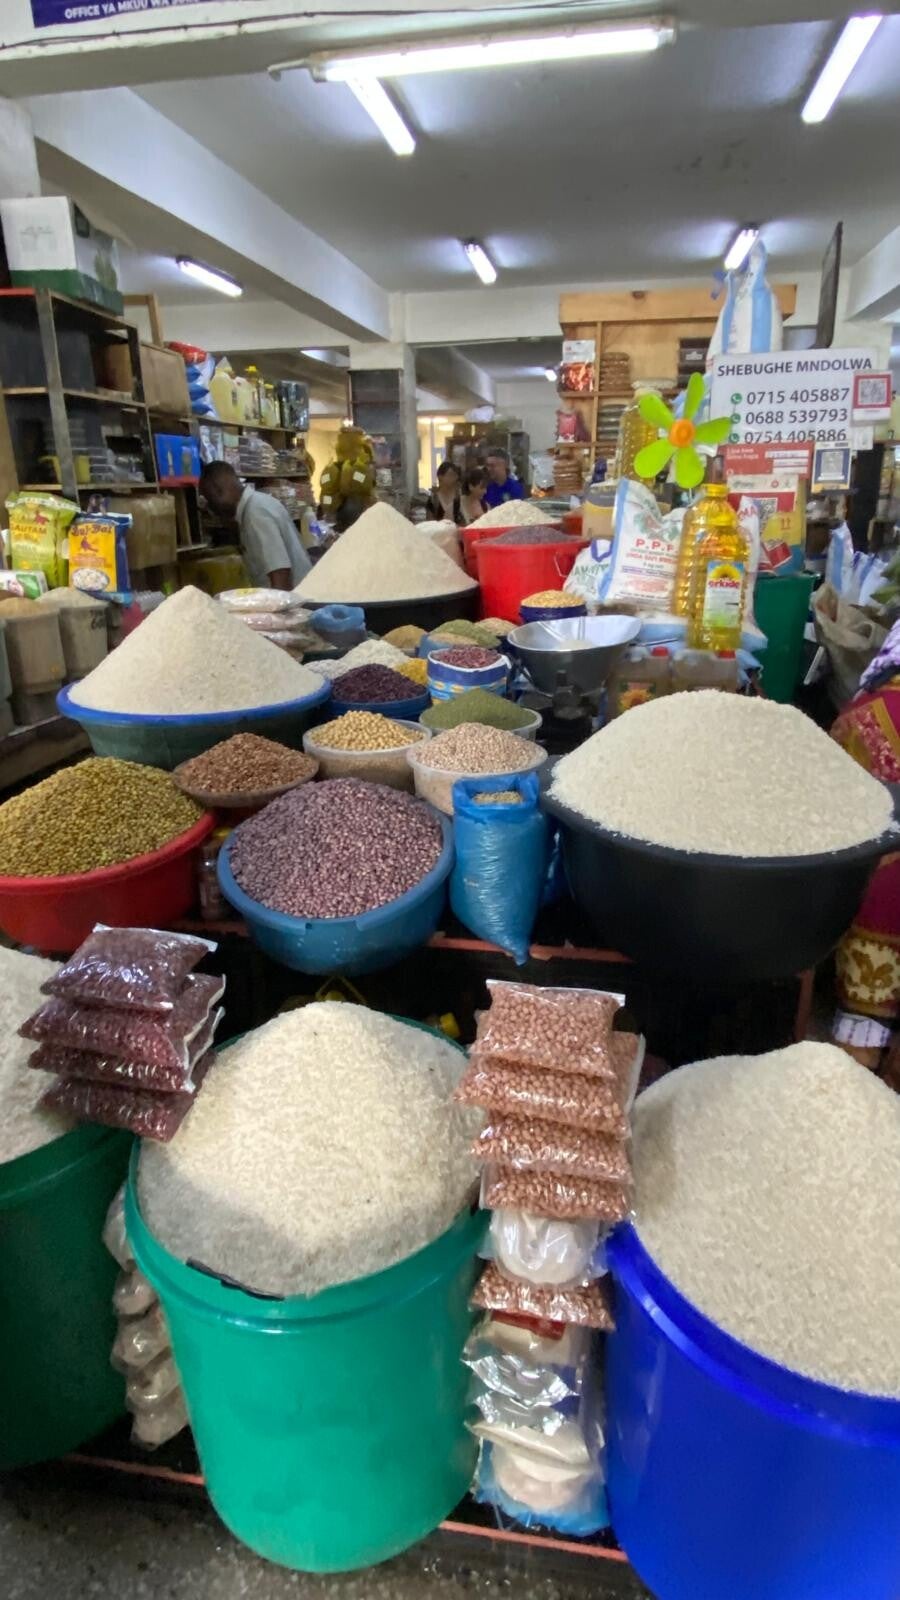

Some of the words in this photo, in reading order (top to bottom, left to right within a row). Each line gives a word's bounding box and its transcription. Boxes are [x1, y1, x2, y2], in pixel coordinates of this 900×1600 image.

[64, 4, 100, 19] OFFICE
[101, 3, 116, 14] YA
[717, 361, 793, 377] SHEBUGHE
[796, 358, 872, 373] MNDOLWA
[746, 390, 785, 405] 0715
[789, 387, 850, 403] 405887
[745, 410, 784, 425] 0688
[788, 408, 848, 424] 539793
[744, 430, 782, 445] 0754
[787, 428, 847, 443] 405886
